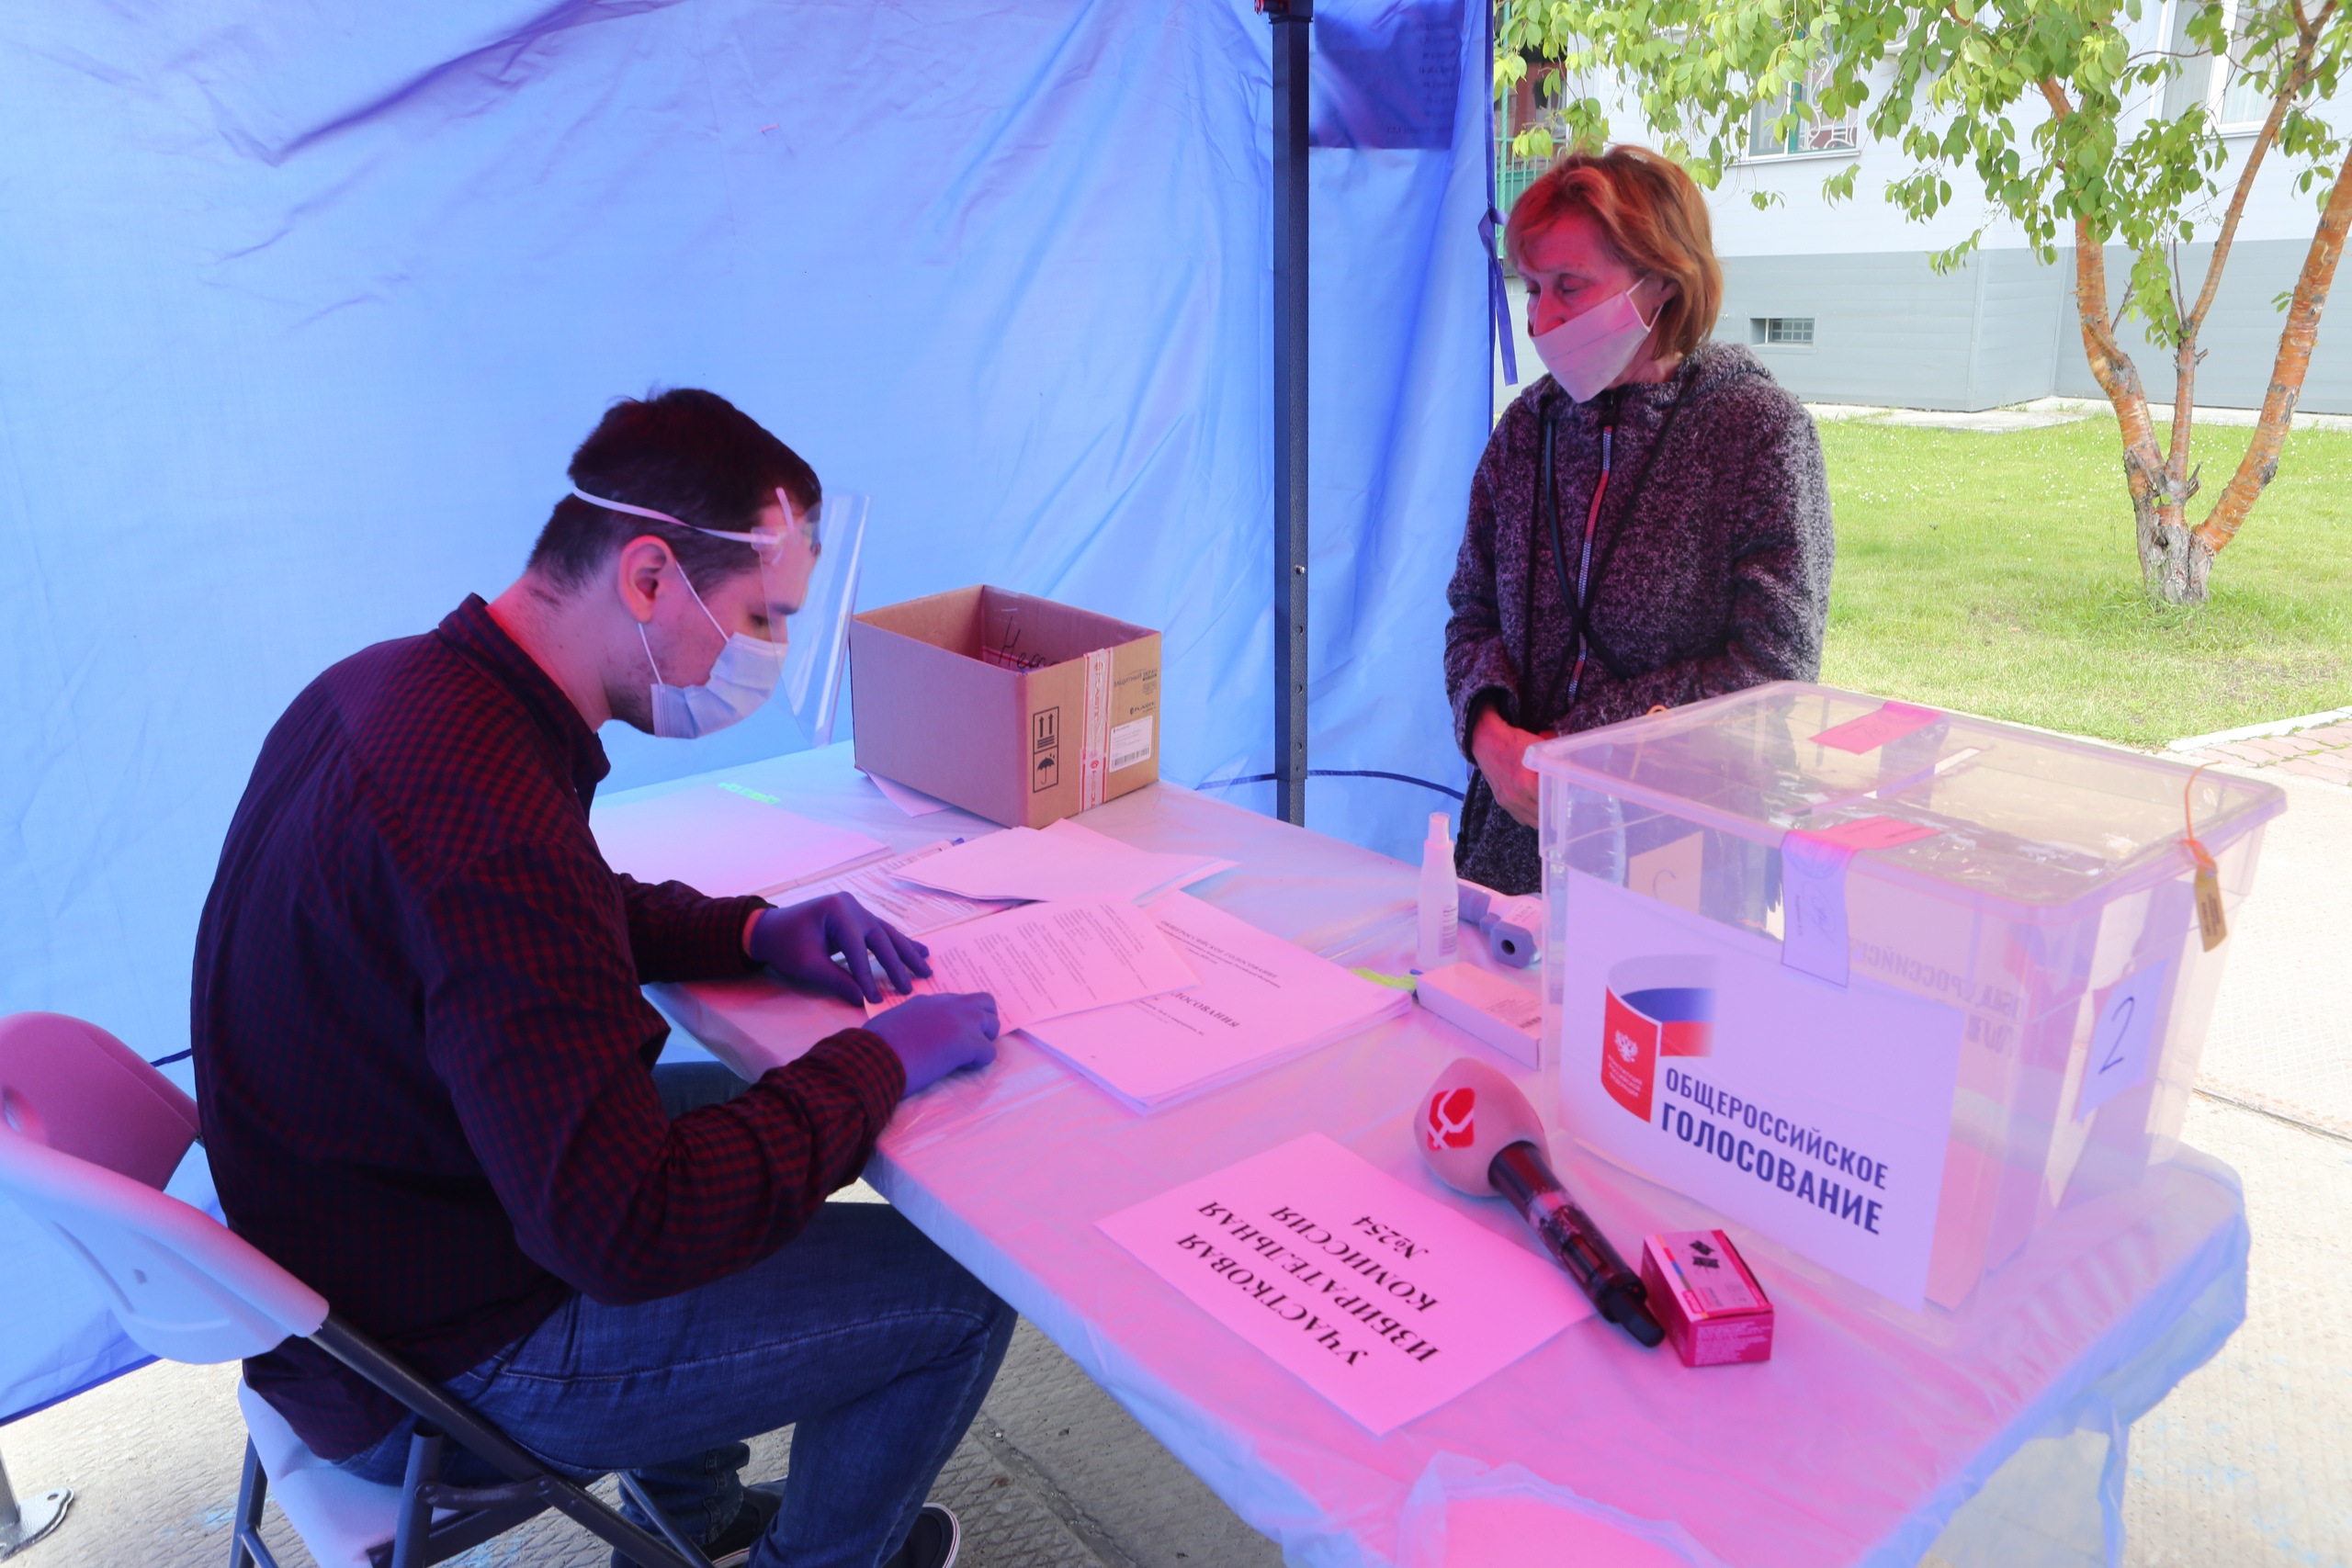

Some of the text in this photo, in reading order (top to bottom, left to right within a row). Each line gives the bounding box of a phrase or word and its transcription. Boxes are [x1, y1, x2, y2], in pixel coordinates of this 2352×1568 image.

[1170, 992, 1240, 1028] ЛОСОВАНИЯ
[2098, 996, 2135, 1076] 2
[1661, 1101, 1883, 1235] ГОЛОСОВАНИЕ
[1666, 1067, 1889, 1190] ОБЩЕРОССИЙСКОЕ
[1195, 1201, 1440, 1363] ИЗБИРАТЕЛЬНАЯ
[1268, 1206, 1440, 1313] КОМИССИЯ
[1351, 1215, 1430, 1259] №254
[1175, 1234, 1369, 1366] УЧАСТКОВАЯ
